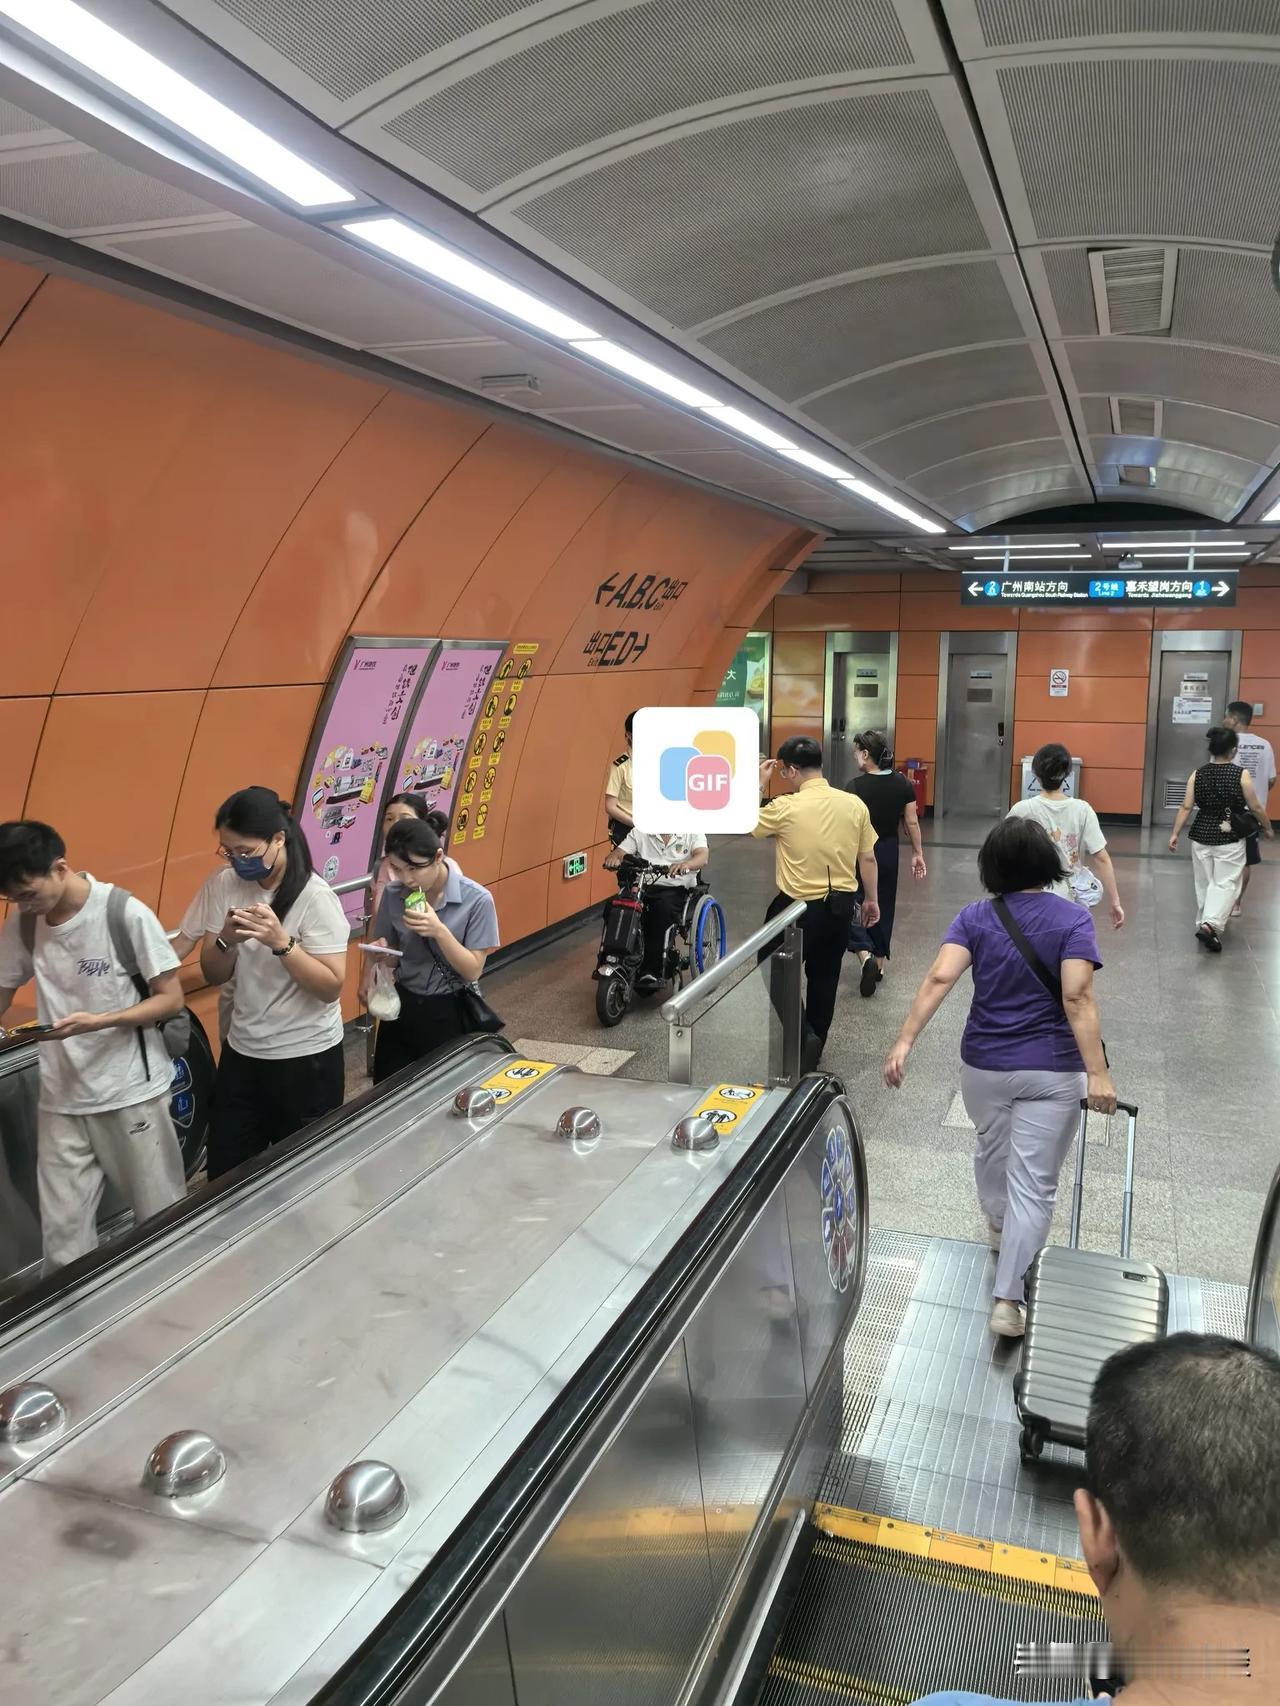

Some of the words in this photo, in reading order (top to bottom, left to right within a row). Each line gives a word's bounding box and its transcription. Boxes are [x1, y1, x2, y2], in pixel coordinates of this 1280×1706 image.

[1001, 581, 1068, 592] 广州南站方向
[1094, 581, 1119, 591] 2号线
[1126, 580, 1193, 592] 嘉禾望岗方向
[583, 630, 612, 654] 出口
